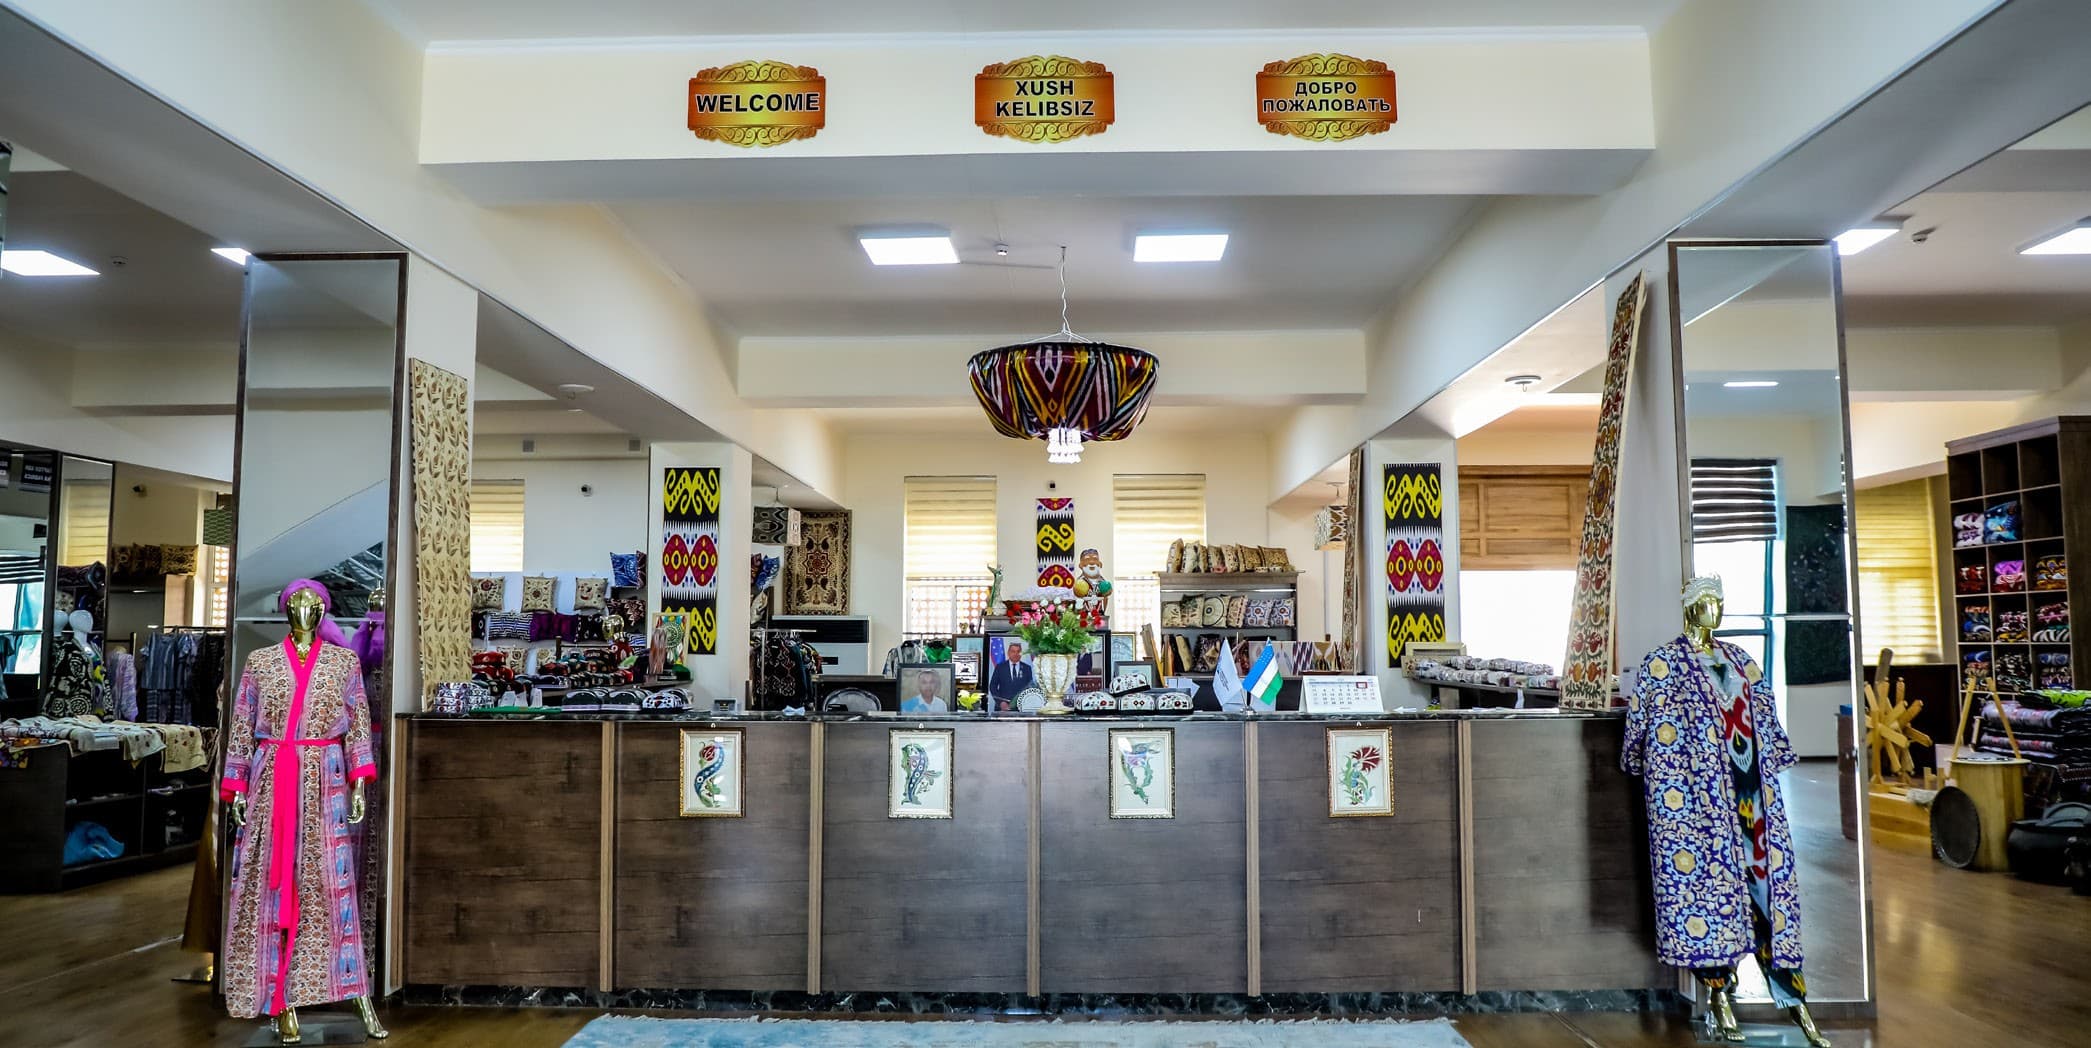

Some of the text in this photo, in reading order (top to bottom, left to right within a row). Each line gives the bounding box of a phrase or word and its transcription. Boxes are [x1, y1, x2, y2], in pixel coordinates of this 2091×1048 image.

[1015, 80, 1074, 96] XUSH
[1295, 81, 1357, 97] ДОБРО
[696, 93, 819, 113] WELCOME
[996, 100, 1095, 117] KELIBSIZ
[1263, 98, 1391, 112] ПОЖАЛОВАТЬ
